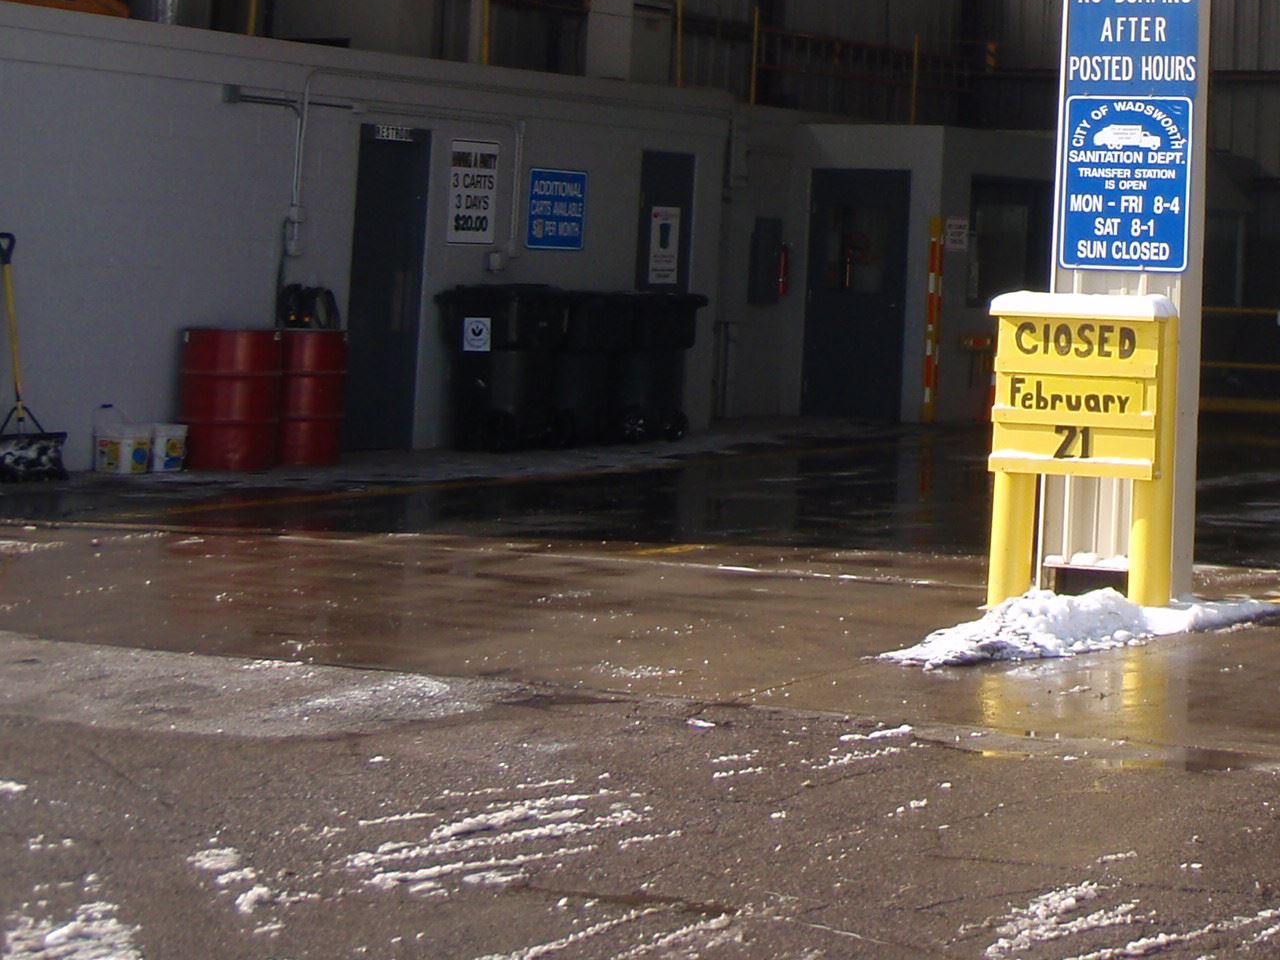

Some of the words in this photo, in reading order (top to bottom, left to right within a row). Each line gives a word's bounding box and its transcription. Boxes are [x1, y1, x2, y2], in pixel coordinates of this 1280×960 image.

[1100, 17, 1167, 42] AFTER
[1069, 55, 1133, 81] POSTED
[1141, 56, 1197, 81] HOURS
[1072, 119, 1092, 147] CITY
[1091, 105, 1109, 120] OF
[1114, 101, 1187, 149] WADSWORTH
[1069, 150, 1143, 163] SANITATION
[1148, 151, 1186, 164] DEPT.
[453, 173, 460, 188] 3
[463, 173, 494, 190] CARTS
[1078, 167, 1131, 178] TRANSFER
[1134, 168, 1176, 179] STATION
[532, 180, 583, 197] ADDITIONAL
[1105, 180, 1116, 190] IS
[1119, 180, 1147, 190] OPEN
[455, 194, 462, 209] 3
[465, 195, 489, 210] DAYS
[1070, 194, 1103, 212] MON
[1120, 195, 1143, 213] FRI
[1153, 196, 1180, 214] 8-4
[1094, 217, 1121, 236] SAT
[1131, 218, 1155, 237] 8-1
[1077, 240, 1107, 259] SUN
[1111, 241, 1170, 260] CLOSED
[1010, 377, 1130, 413] February
[1053, 425, 1090, 459] 21
